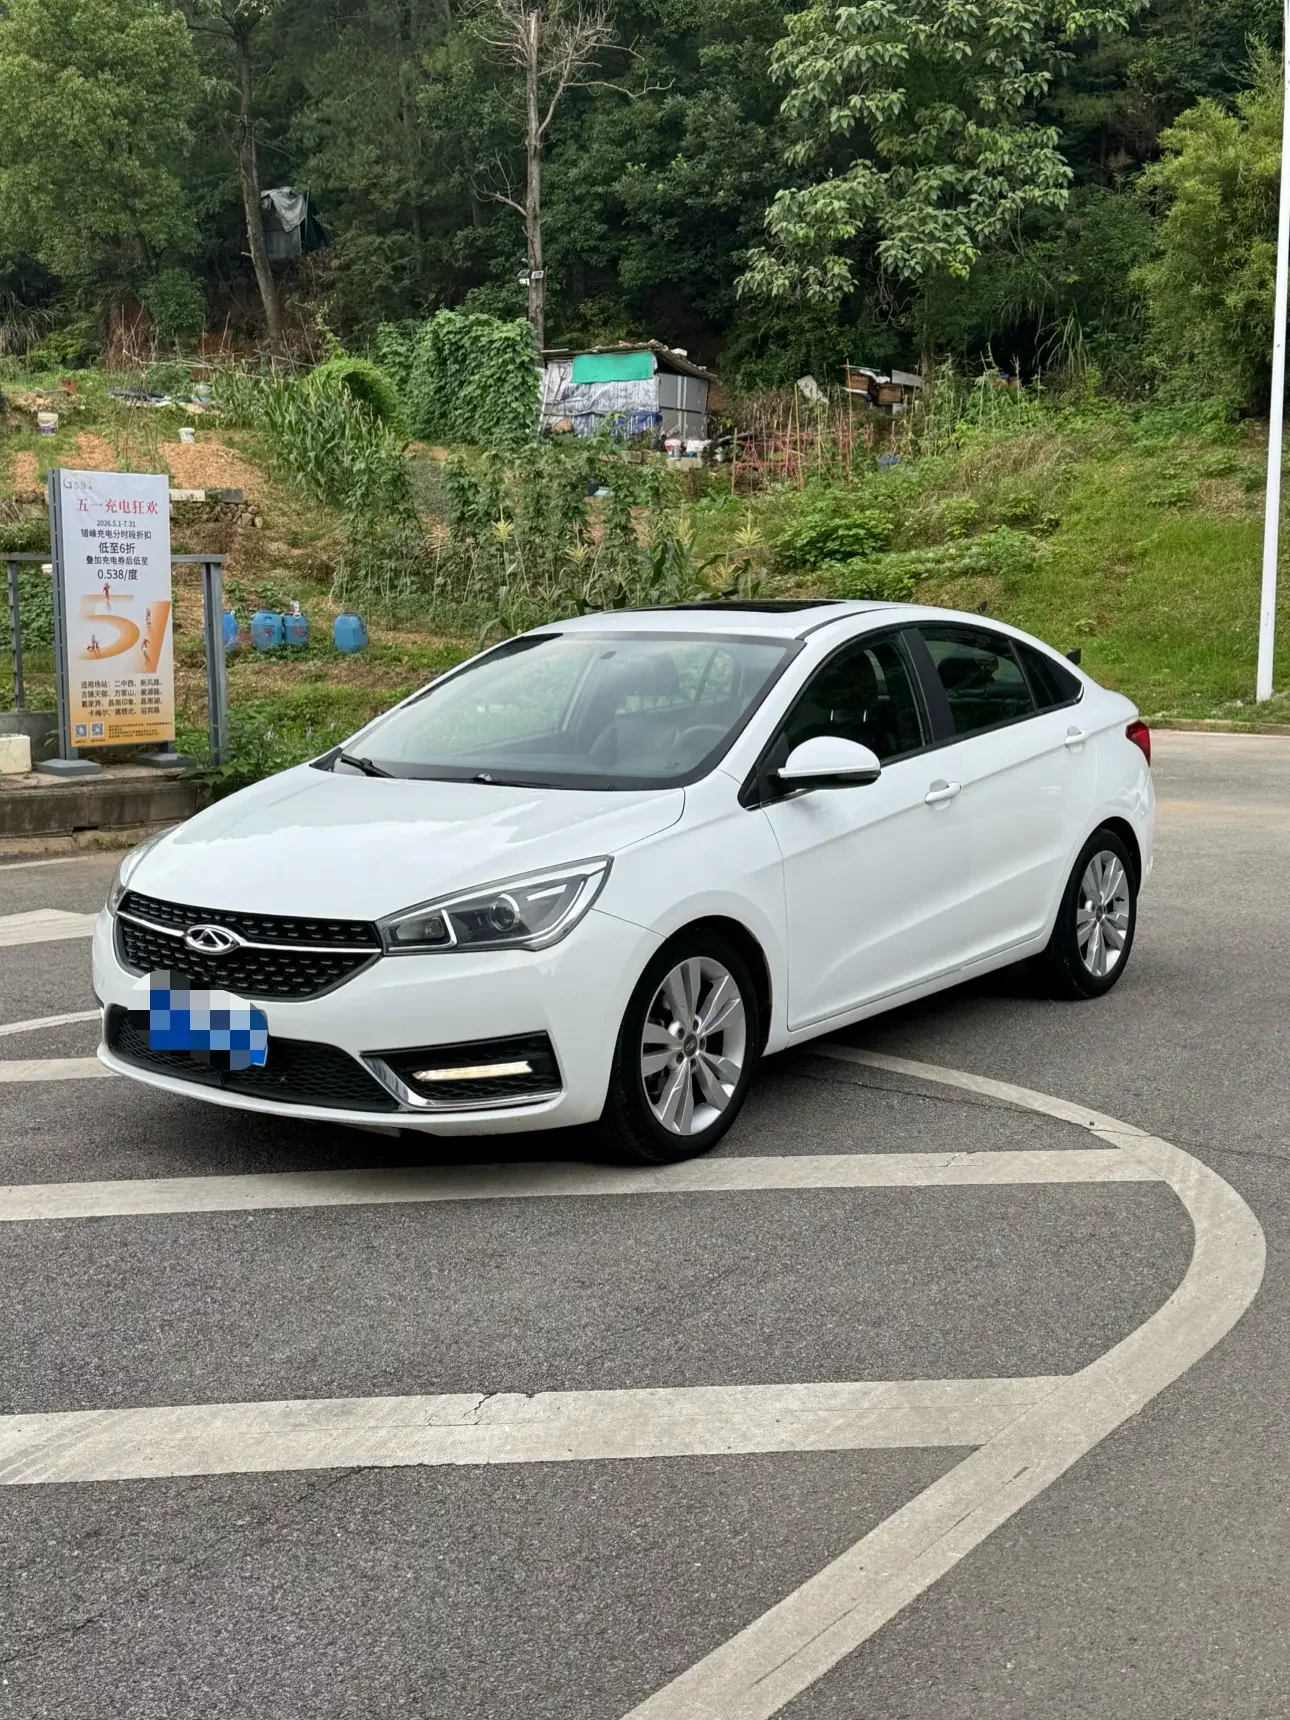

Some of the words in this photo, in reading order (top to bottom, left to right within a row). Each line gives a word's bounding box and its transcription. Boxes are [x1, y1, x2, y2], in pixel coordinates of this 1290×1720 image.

[77, 498, 158, 515] 五一充电狂欢
[97, 520, 136, 528] 2026.5.1-7.31
[81, 529, 152, 540] 错峰充电分时段折扣
[99, 542, 136, 555] 低至6折
[86, 556, 149, 566] 叠加充电券后低至
[97, 569, 138, 581] 0.538/度
